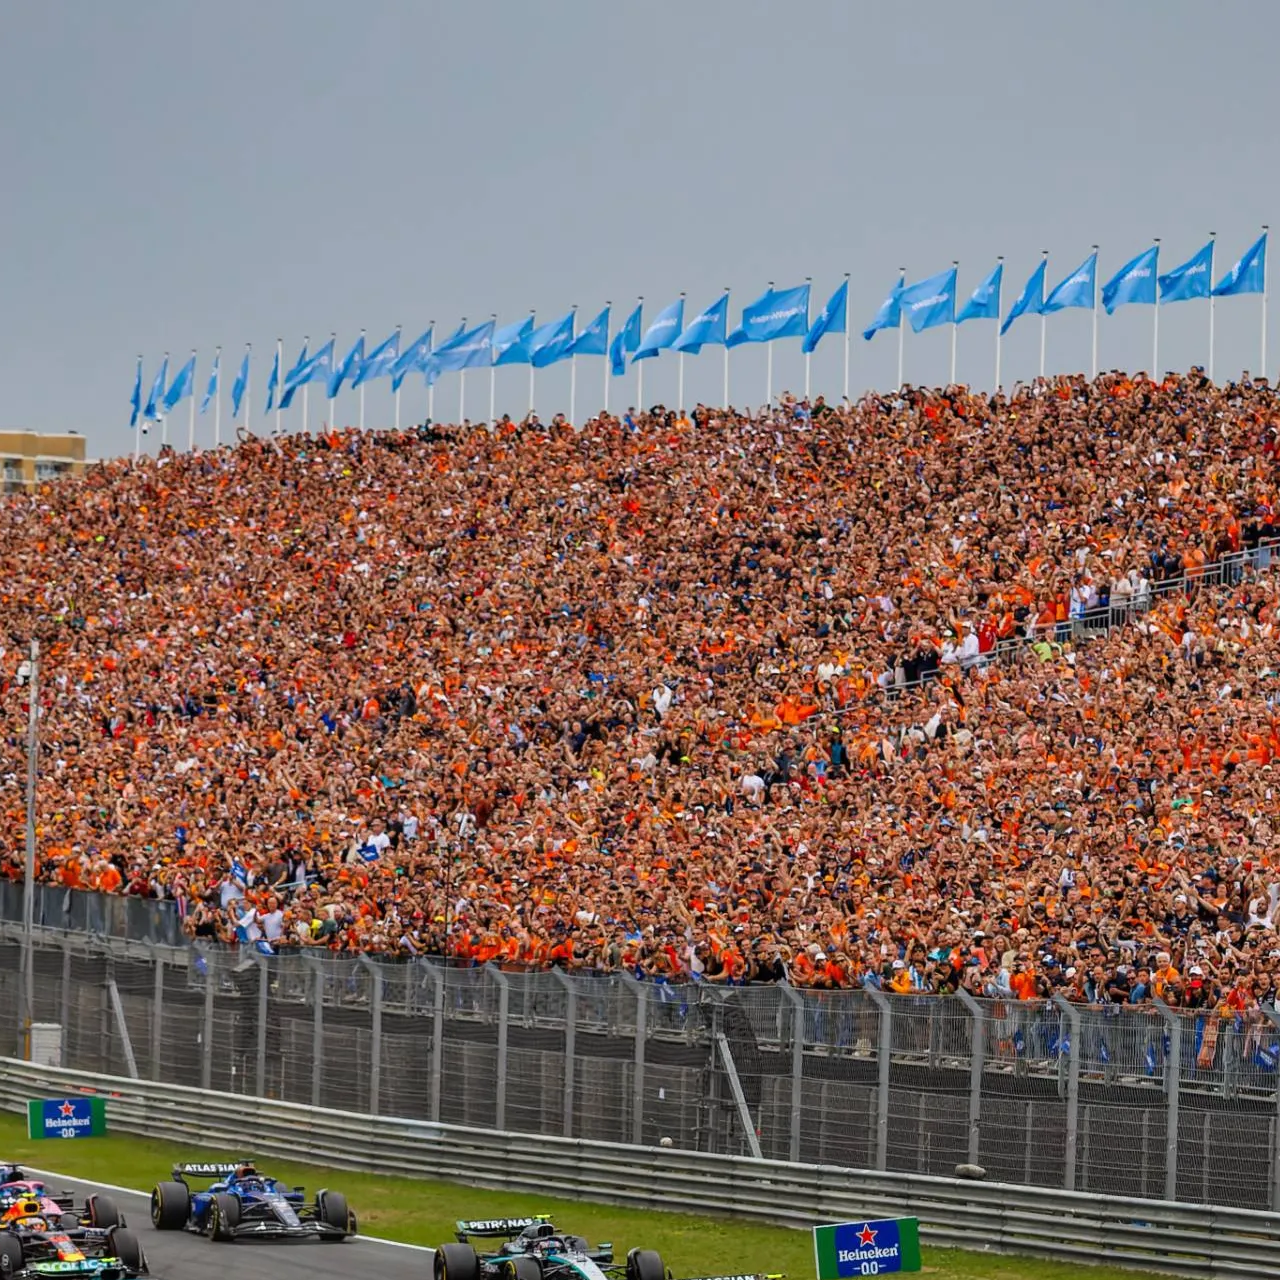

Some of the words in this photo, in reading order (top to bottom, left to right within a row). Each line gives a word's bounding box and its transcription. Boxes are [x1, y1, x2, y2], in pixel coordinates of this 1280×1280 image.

[469, 1217, 533, 1230] PETRONAS
[838, 1246, 898, 1262] Heineken
[861, 1261, 879, 1275] 0.0
